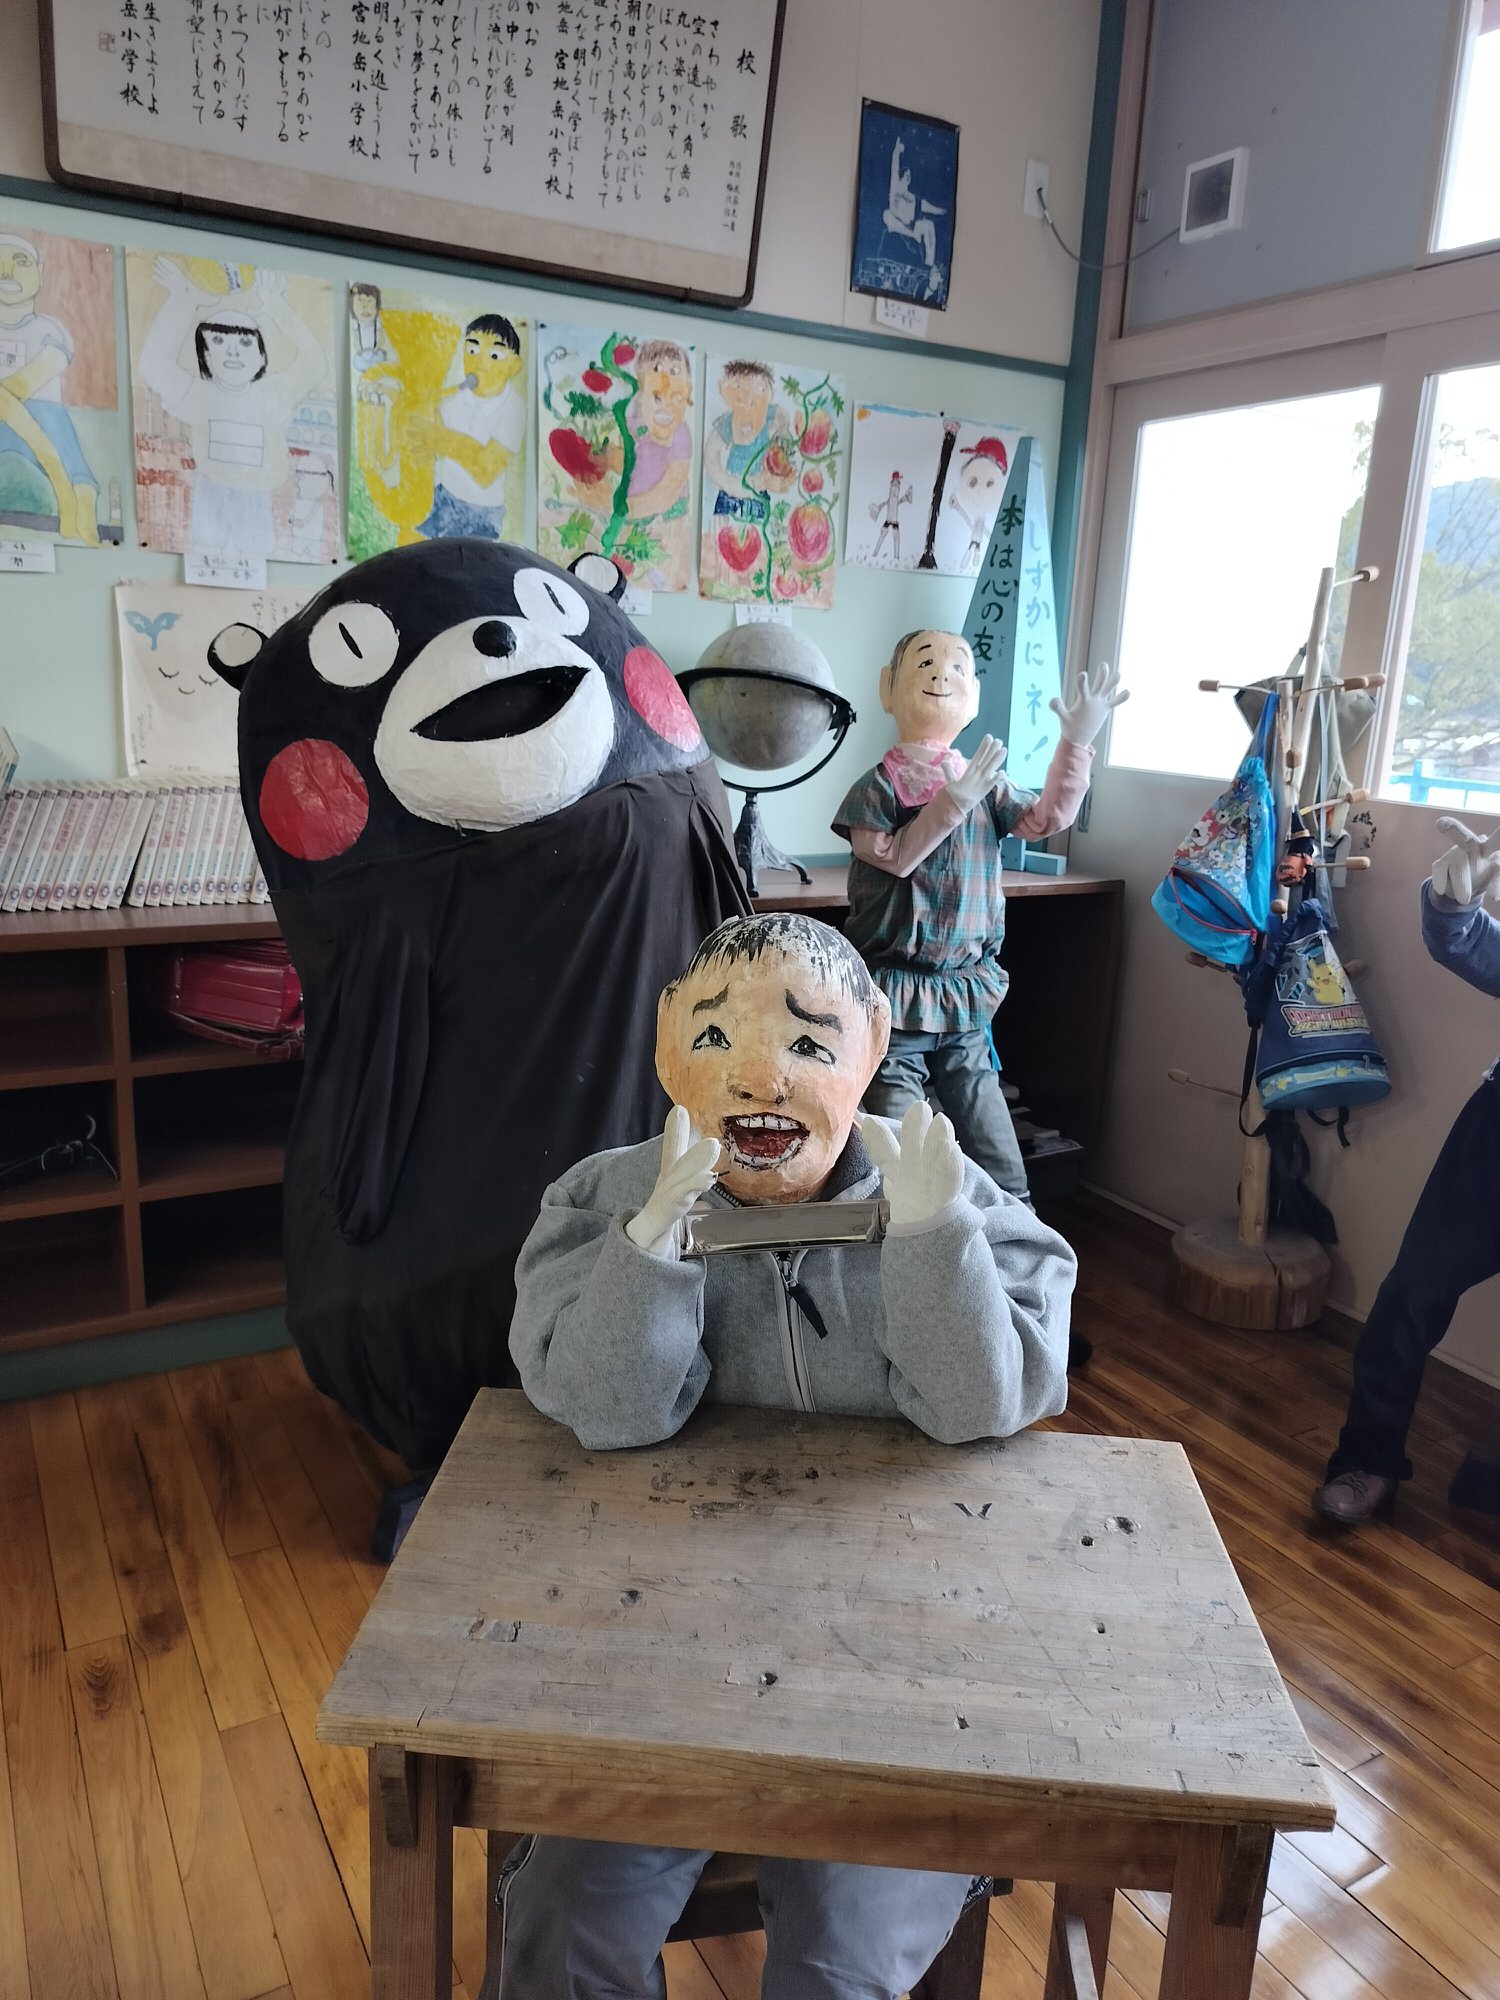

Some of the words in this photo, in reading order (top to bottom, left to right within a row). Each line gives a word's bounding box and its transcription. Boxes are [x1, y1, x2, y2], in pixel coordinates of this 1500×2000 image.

[348, 1, 370, 157] 宮地岳小学校
[565, 0, 587, 200] んな明るく学ぼうよ
[651, 6, 673, 127] ぼくたちの
[699, 19, 720, 140] さわやかな
[729, 48, 757, 141] 校歌
[972, 494, 1023, 677] 本は心の友
